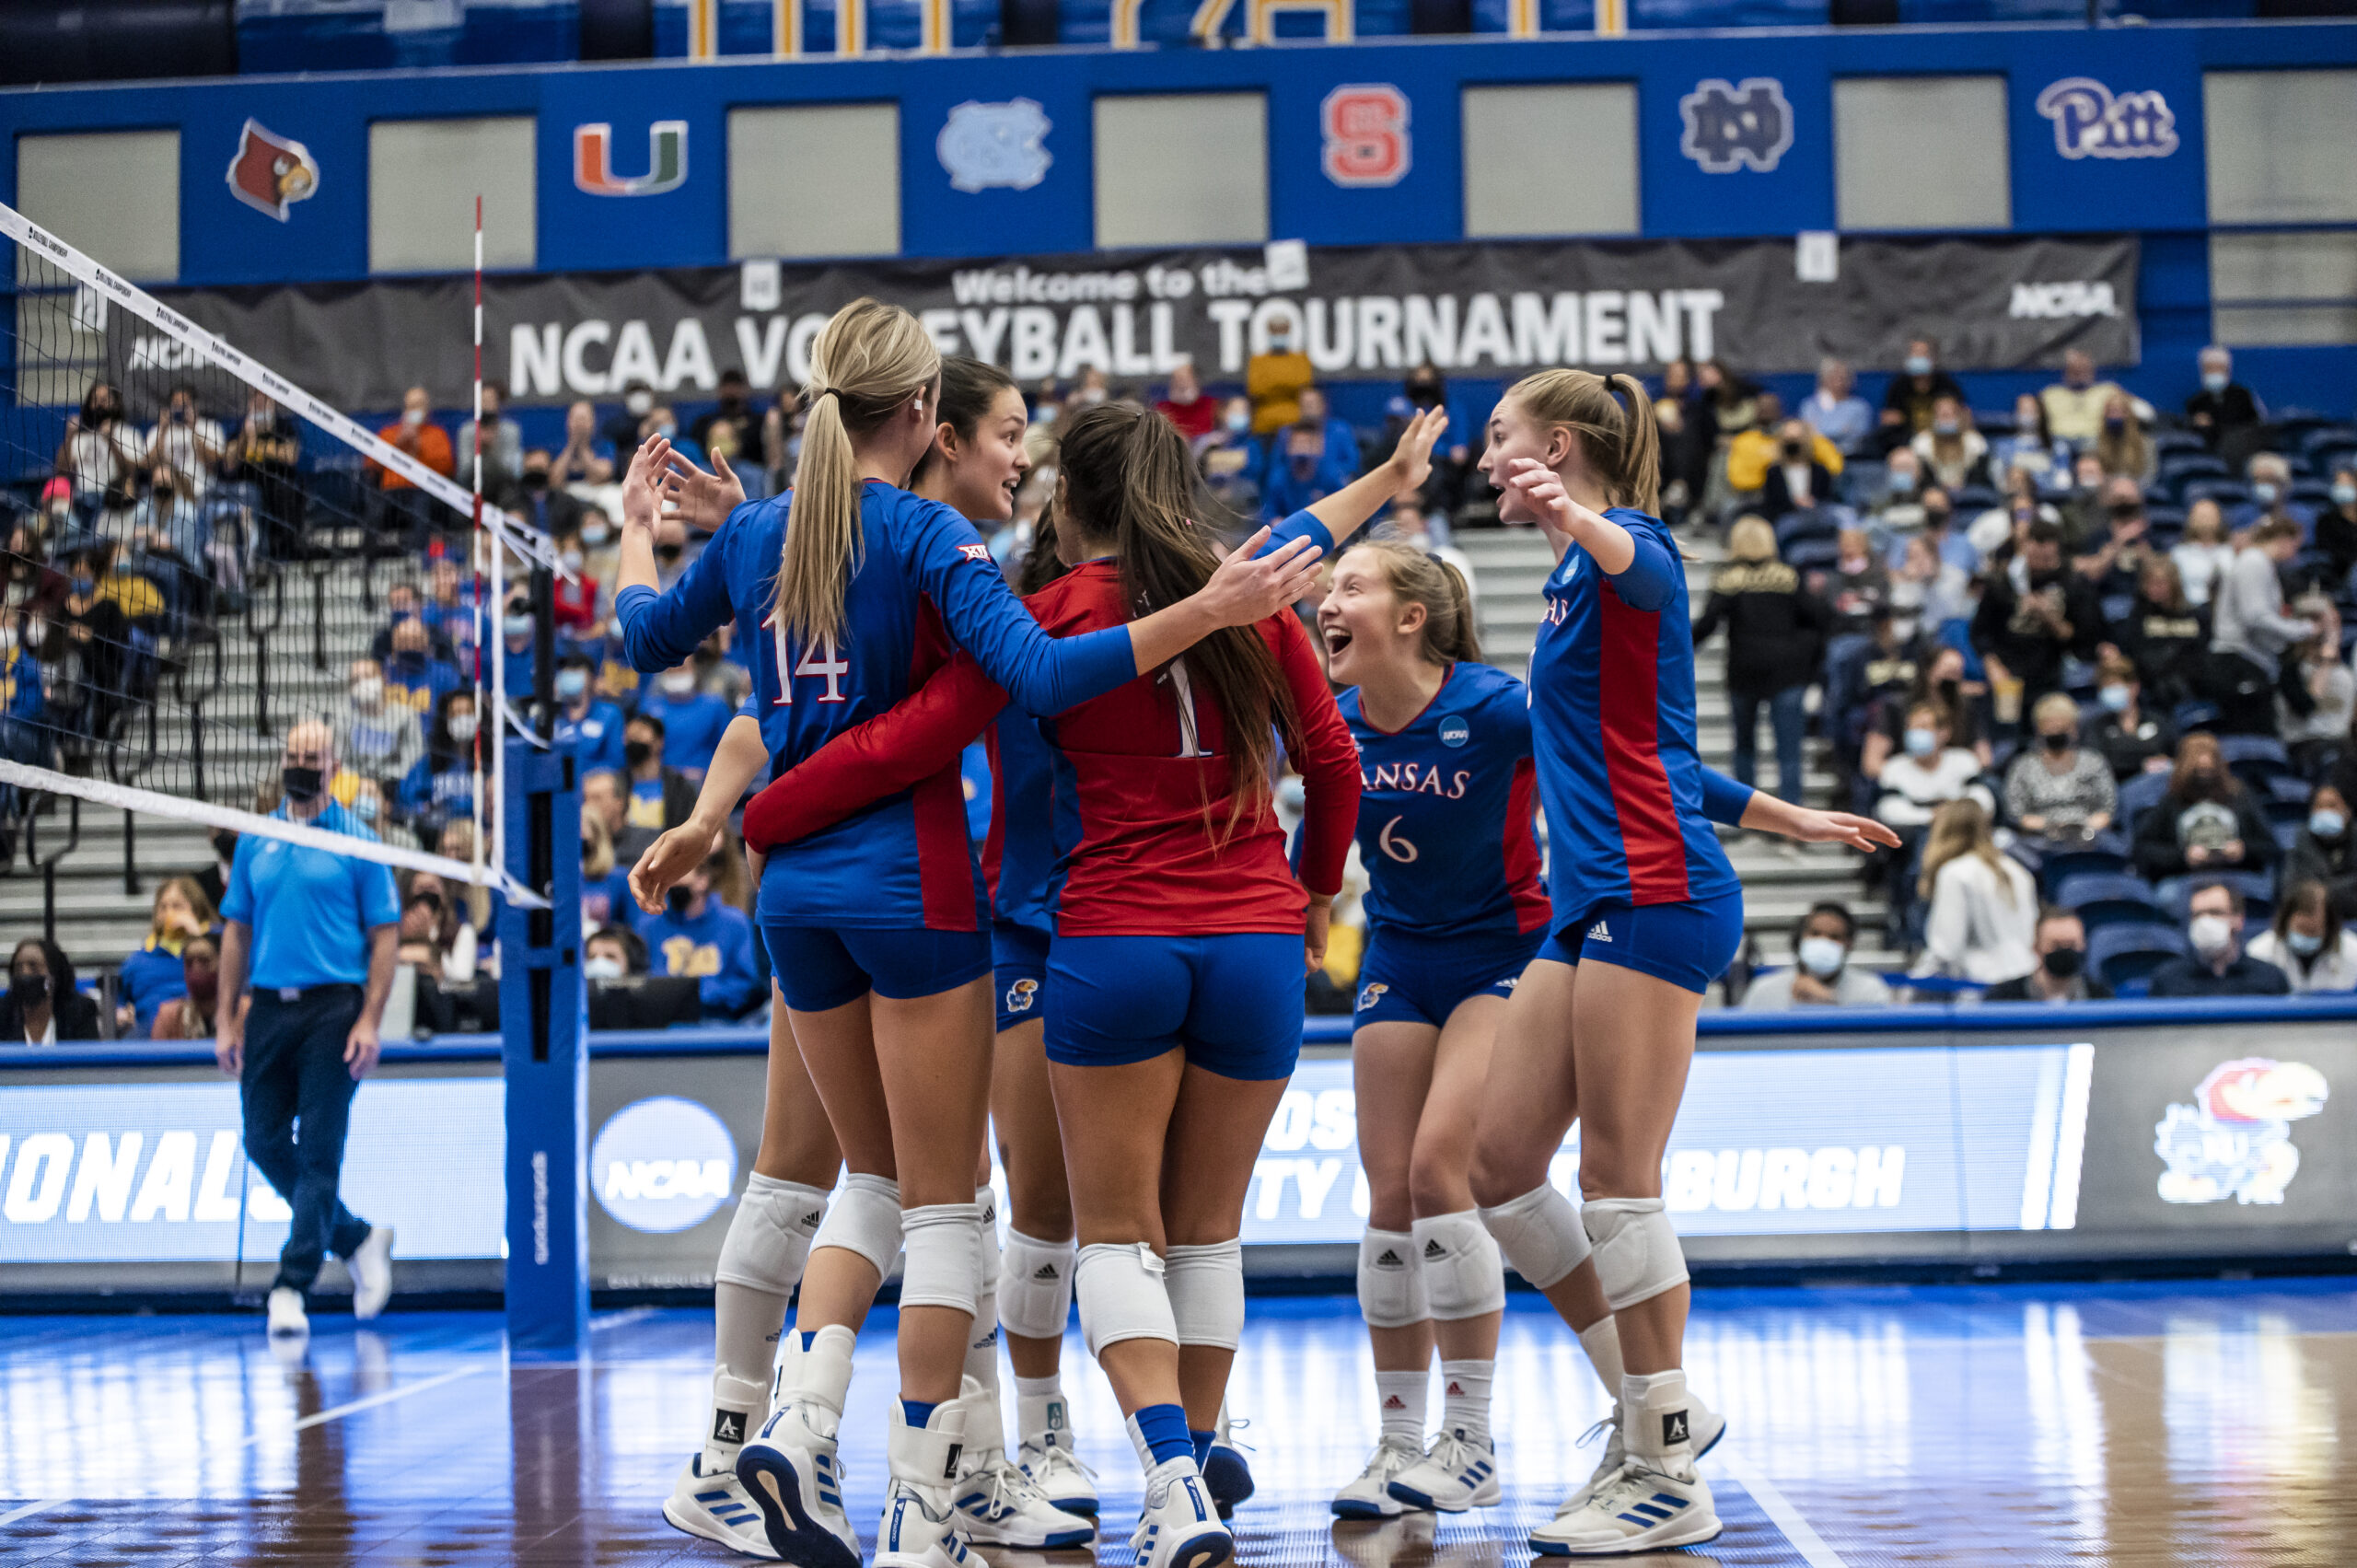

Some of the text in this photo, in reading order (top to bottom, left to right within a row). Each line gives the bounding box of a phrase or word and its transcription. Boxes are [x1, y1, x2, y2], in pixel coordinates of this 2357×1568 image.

[2036, 76, 2179, 160] Pitt
[574, 118, 689, 197] U
[952, 259, 1269, 305] Welcome to the
[2008, 280, 2117, 319] NCAA
[509, 287, 1724, 398] NCAA VOEYBALL TOURNAMENT
[760, 604, 849, 706] 14
[1378, 814, 1419, 865] 6
[605, 1159, 731, 1201] NCAA
